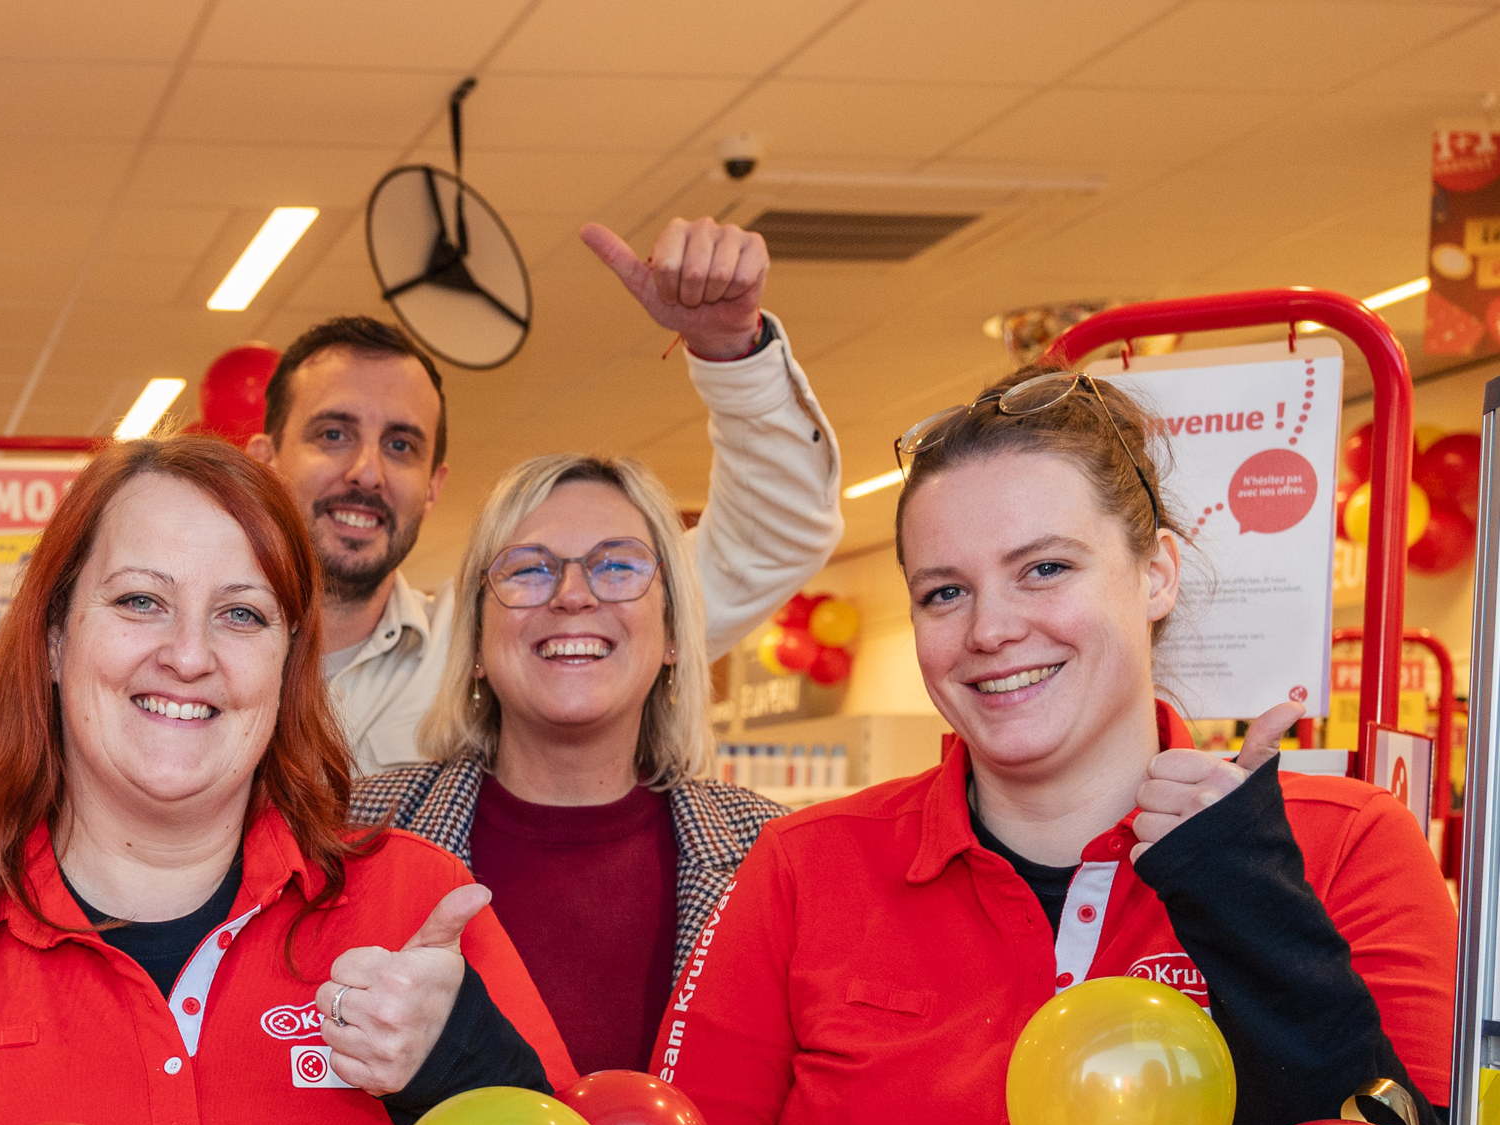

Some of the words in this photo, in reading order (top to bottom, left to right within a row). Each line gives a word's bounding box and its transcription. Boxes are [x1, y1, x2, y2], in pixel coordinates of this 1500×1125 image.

[1287, 474, 1302, 485] pas
[1260, 487, 1276, 496] nos
[660, 1020, 686, 1084] eam
[674, 880, 737, 1012] Kruidvat
